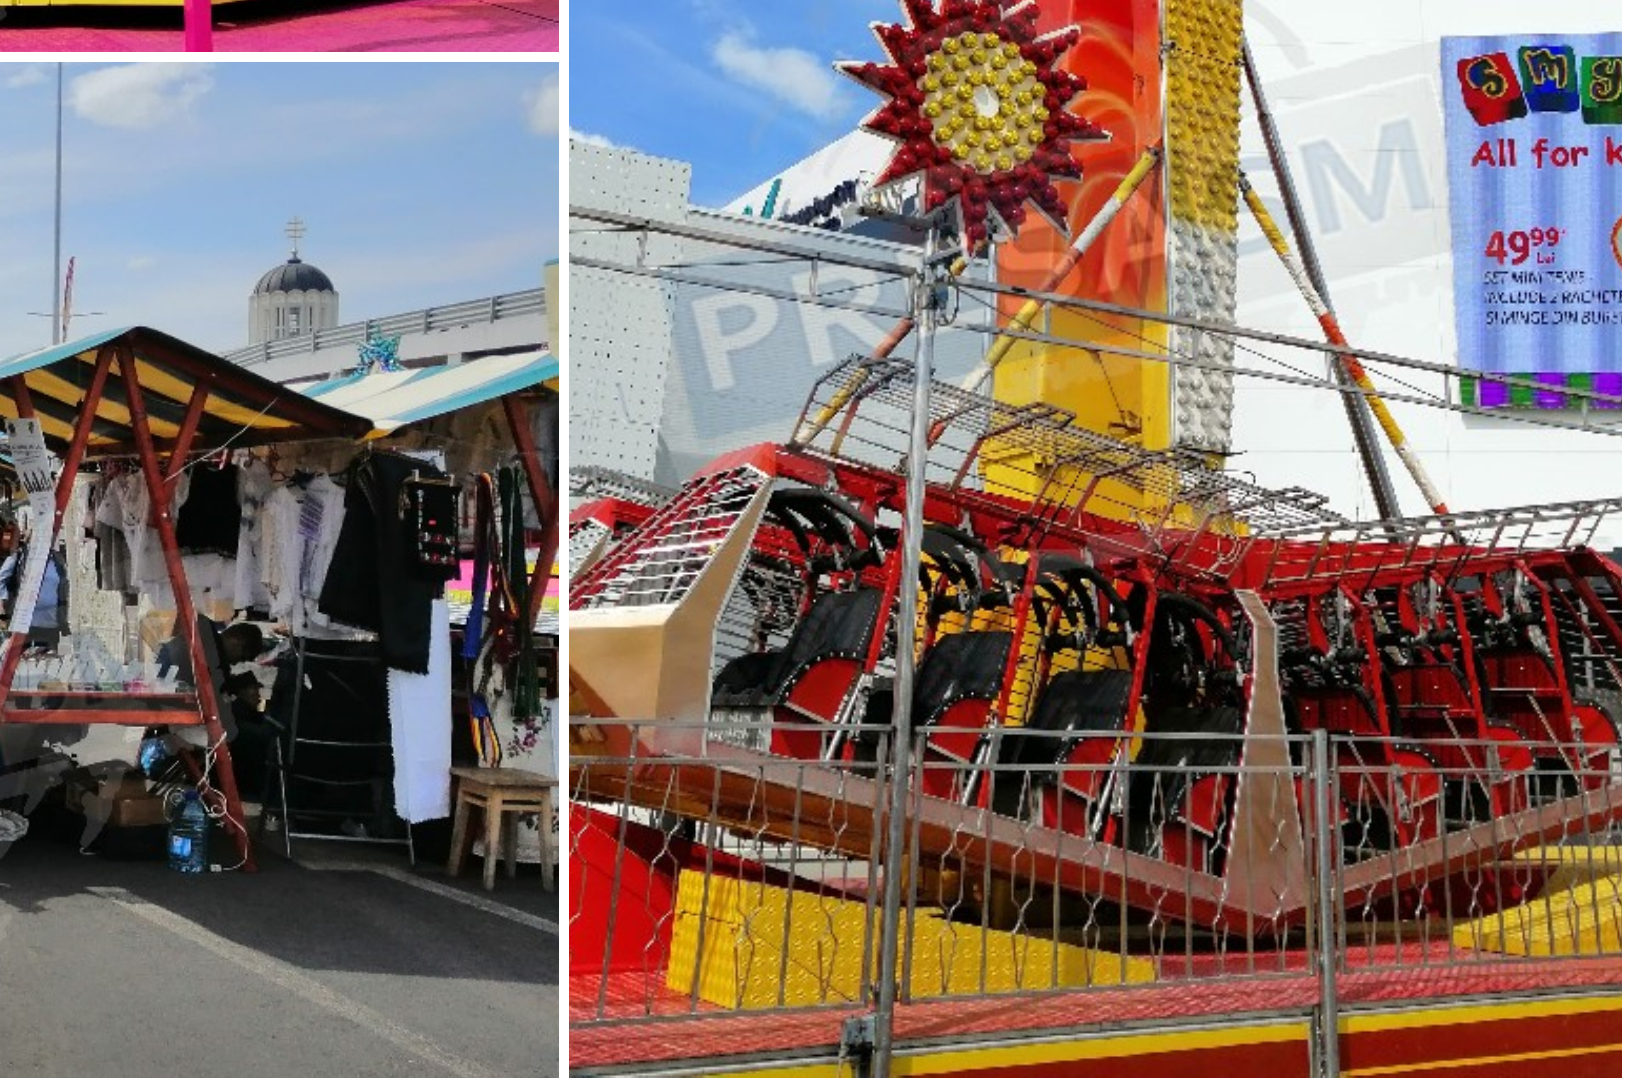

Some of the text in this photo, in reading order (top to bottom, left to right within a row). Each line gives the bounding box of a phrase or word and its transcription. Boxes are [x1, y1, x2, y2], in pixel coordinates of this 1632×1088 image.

[1471, 138, 1517, 167] All
[1531, 138, 1589, 168] for
[1581, 311, 1622, 325] BURE
